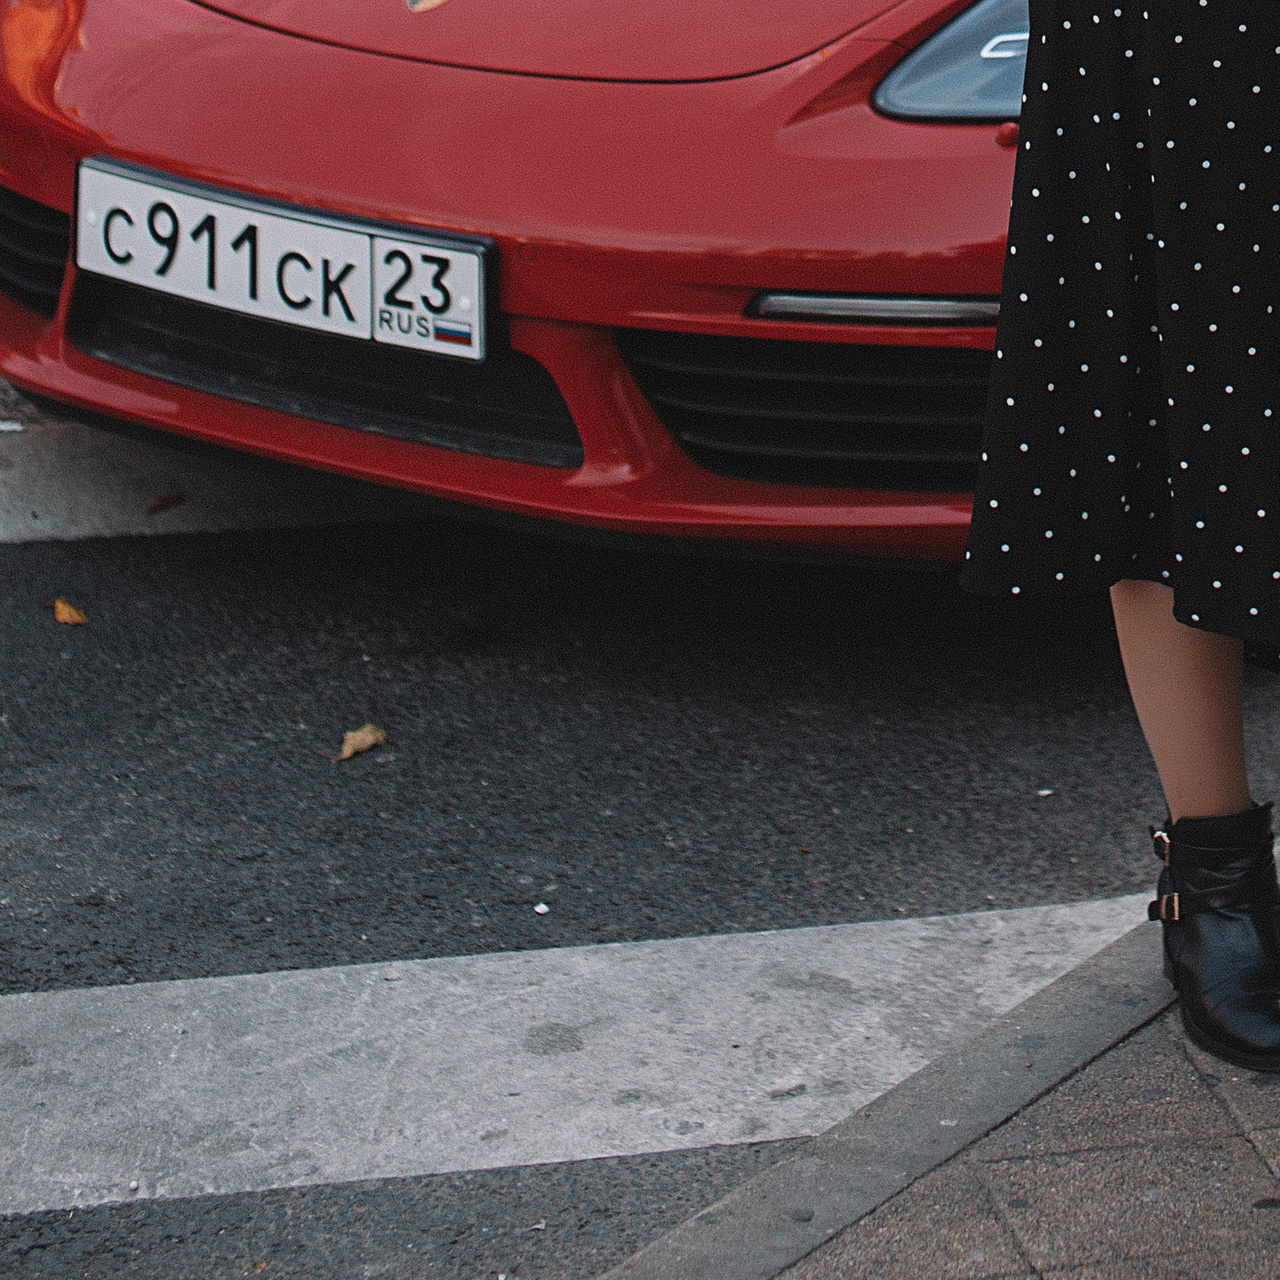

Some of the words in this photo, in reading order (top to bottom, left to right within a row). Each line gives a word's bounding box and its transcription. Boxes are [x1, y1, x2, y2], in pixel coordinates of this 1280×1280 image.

[103, 202, 356, 322] C911CK
[384, 250, 452, 315] 23
[380, 308, 430, 338] RUS
